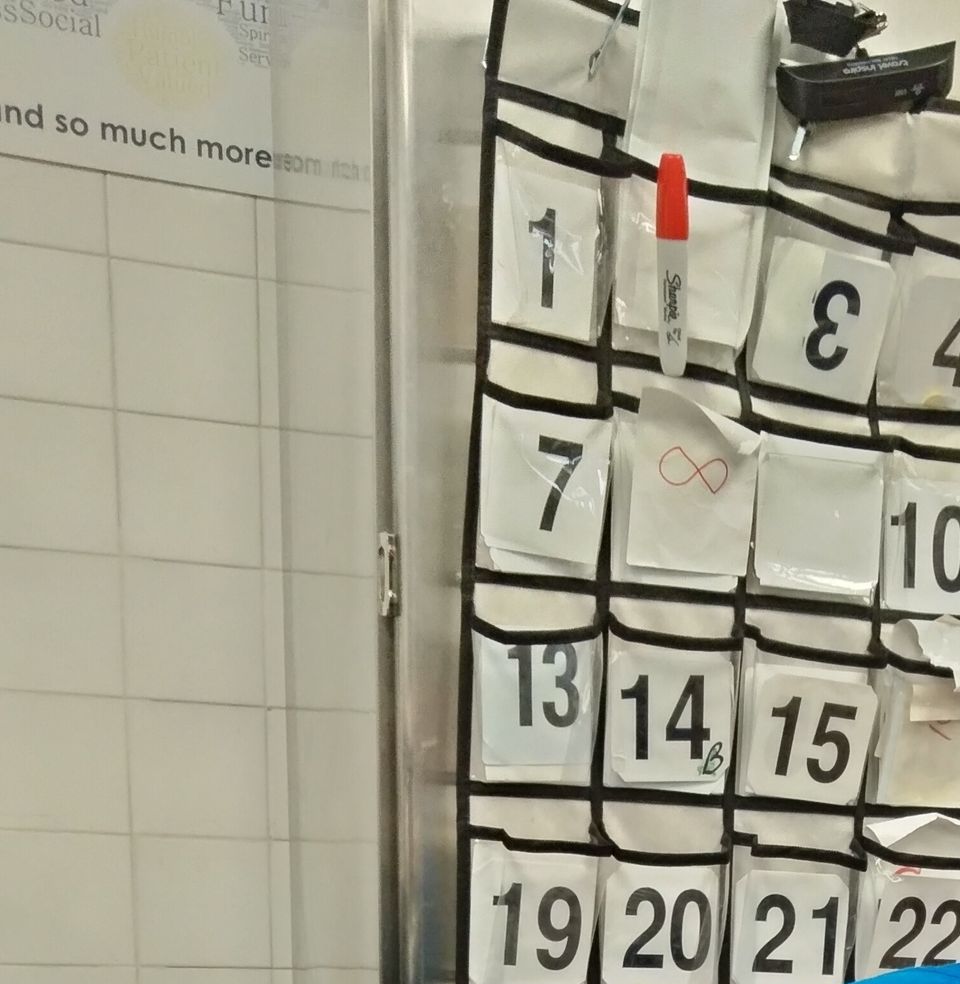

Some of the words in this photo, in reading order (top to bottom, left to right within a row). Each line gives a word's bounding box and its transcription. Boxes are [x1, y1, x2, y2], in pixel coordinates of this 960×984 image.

[0, 0, 101, 38] sSocial
[0, 104, 44, 130] nd
[55, 113, 89, 137] so
[100, 120, 187, 155] much
[196, 138, 273, 170] more
[528, 207, 556, 310] 1
[665, 269, 682, 324] Sharpie
[538, 434, 584, 532] 7
[506, 643, 581, 728] 13
[620, 674, 711, 761] 14
[770, 695, 858, 785] 15
[492, 882, 583, 971] 19
[622, 886, 713, 971] 20
[751, 893, 840, 976] 21
